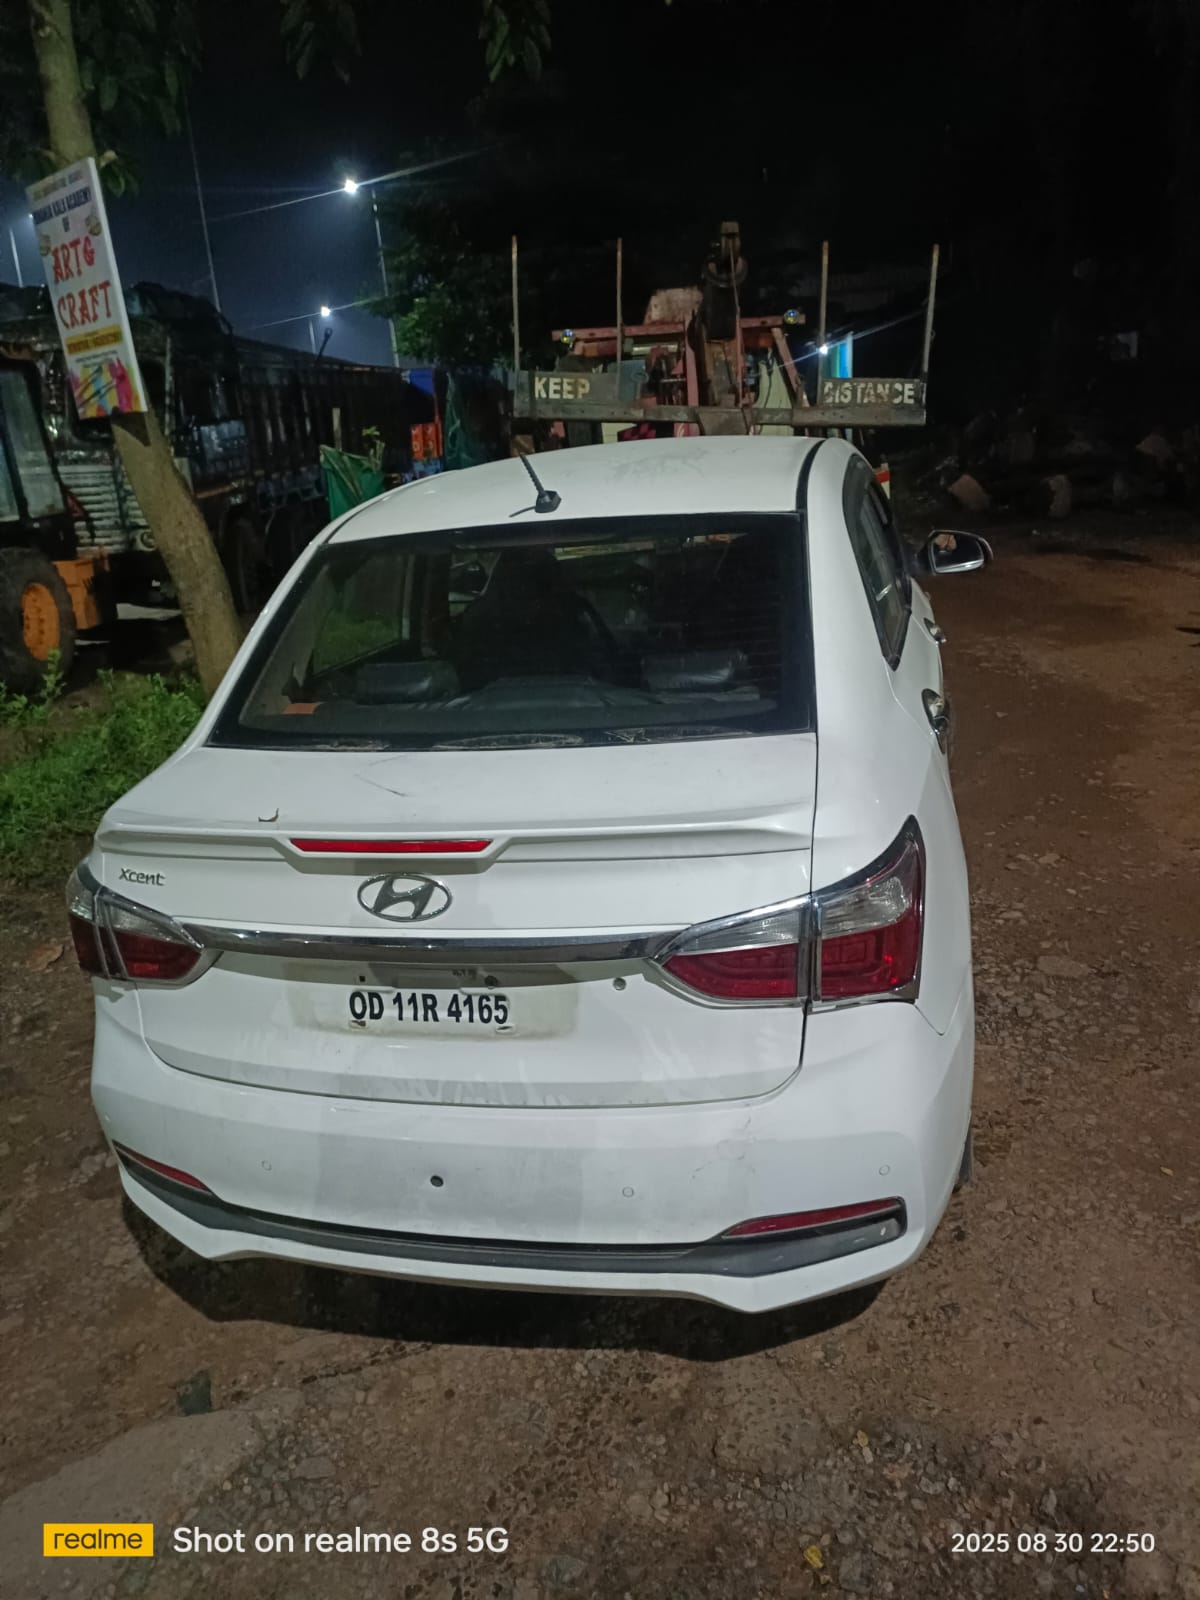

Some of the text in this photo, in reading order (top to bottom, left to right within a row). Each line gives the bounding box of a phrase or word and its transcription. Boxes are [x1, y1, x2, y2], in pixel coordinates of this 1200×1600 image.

[57, 280, 111, 329] CRAFT
[534, 376, 915, 404] KEEP DISTANCE
[118, 867, 166, 886] Xcent
[349, 990, 509, 1025] OD 11R 4165
